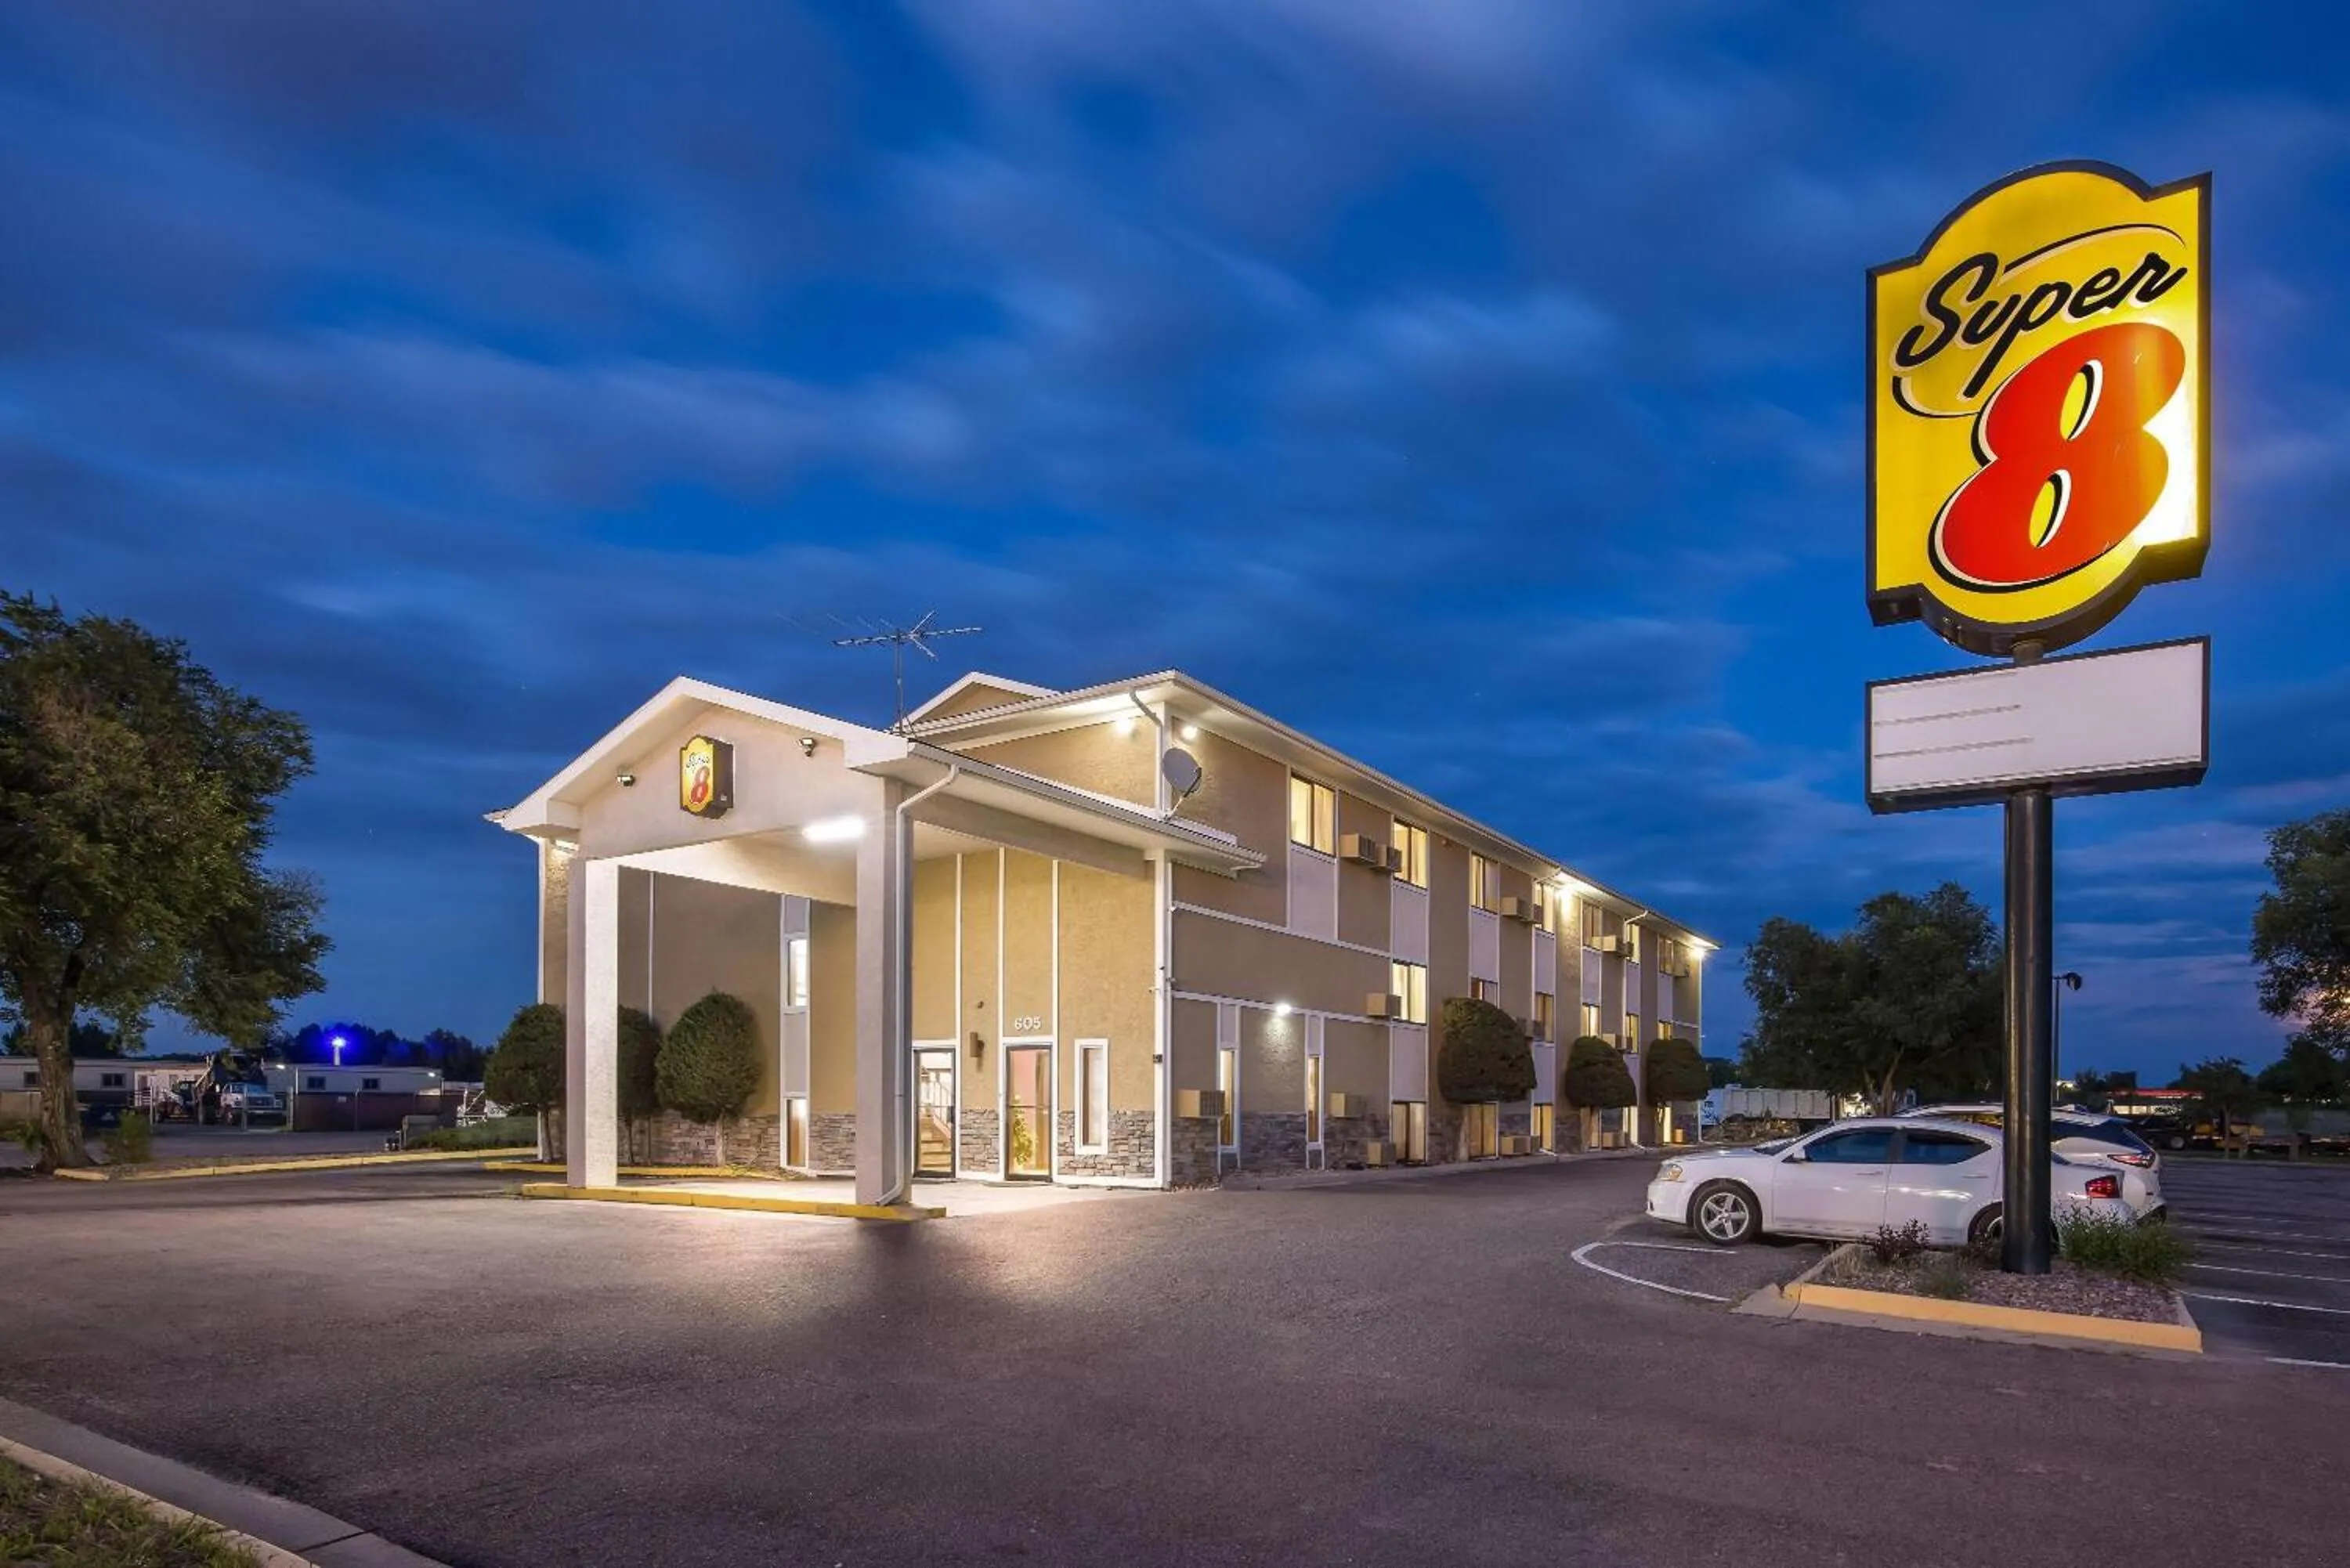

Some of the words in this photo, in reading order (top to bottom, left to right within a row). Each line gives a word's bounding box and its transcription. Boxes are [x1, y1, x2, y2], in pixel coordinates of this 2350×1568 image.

[1894, 251, 2188, 399] Super
[1928, 322, 2186, 594] 8
[689, 766, 710, 804] 8
[1014, 1016, 1041, 1030] 605
